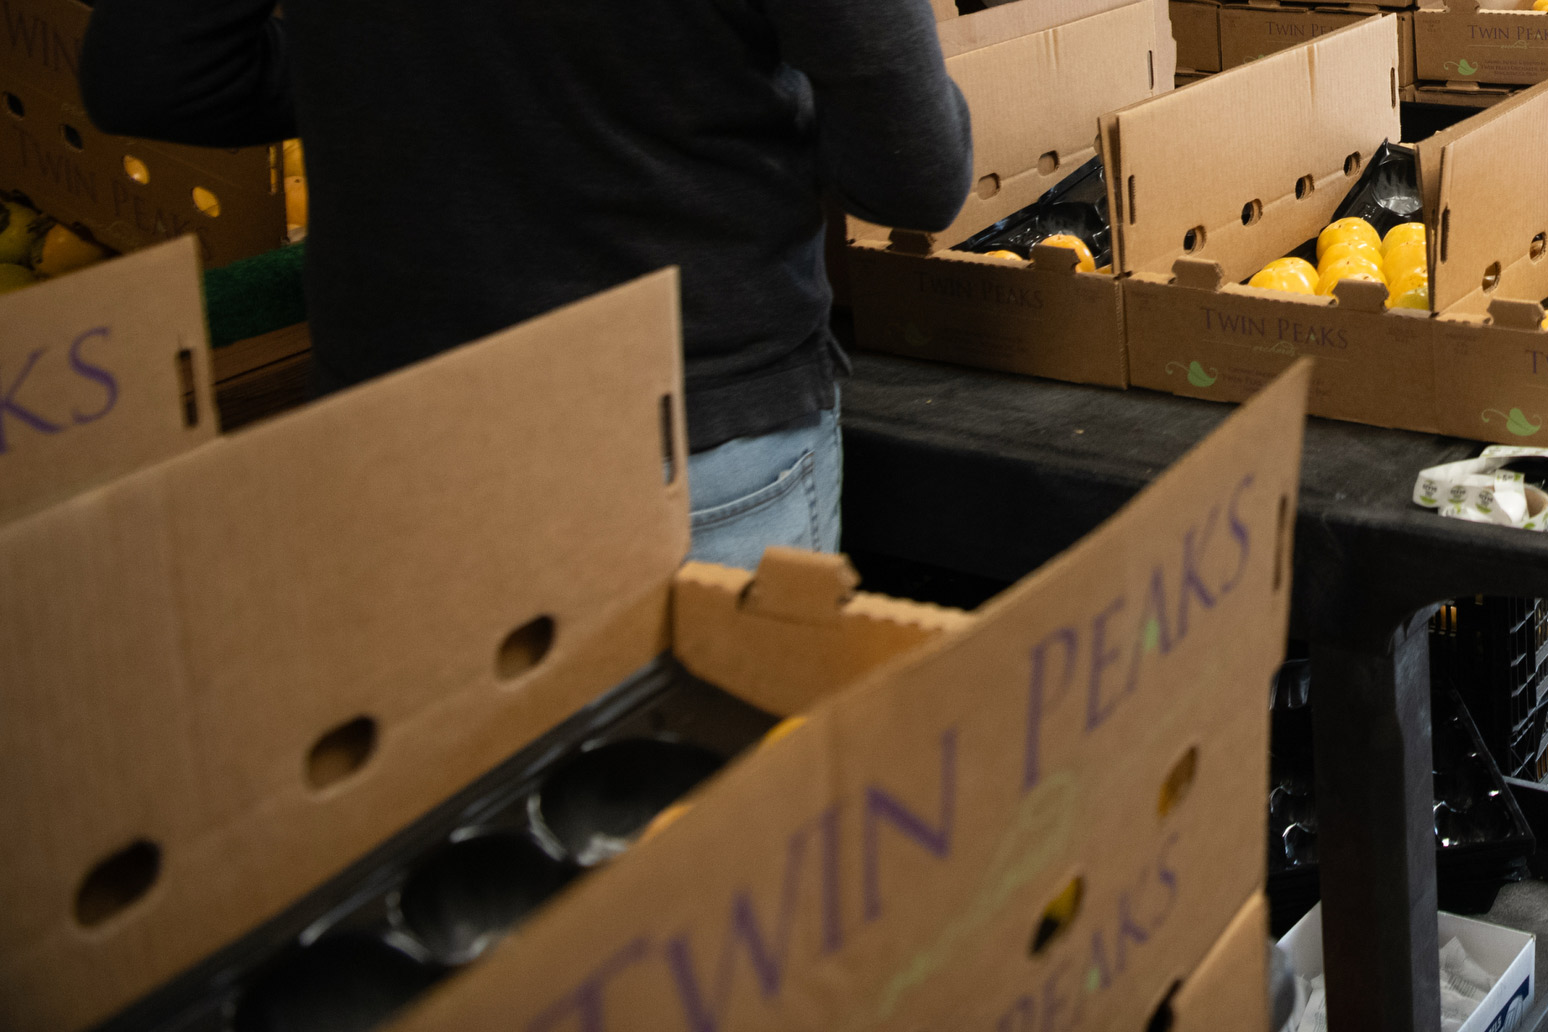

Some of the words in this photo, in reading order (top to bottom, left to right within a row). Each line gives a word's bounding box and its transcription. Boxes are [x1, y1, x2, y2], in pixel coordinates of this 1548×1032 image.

[0, 0, 81, 72] WIN
[1265, 21, 1305, 36] TWIN
[1467, 24, 1511, 40] TWIN
[12, 123, 97, 205] TWIN
[912, 270, 974, 299] TWIN
[981, 278, 1044, 310] PEAKS
[1200, 306, 1266, 337] TWIN
[1276, 317, 1349, 350] PEAKS
[1022, 472, 1254, 793] PEAKS
